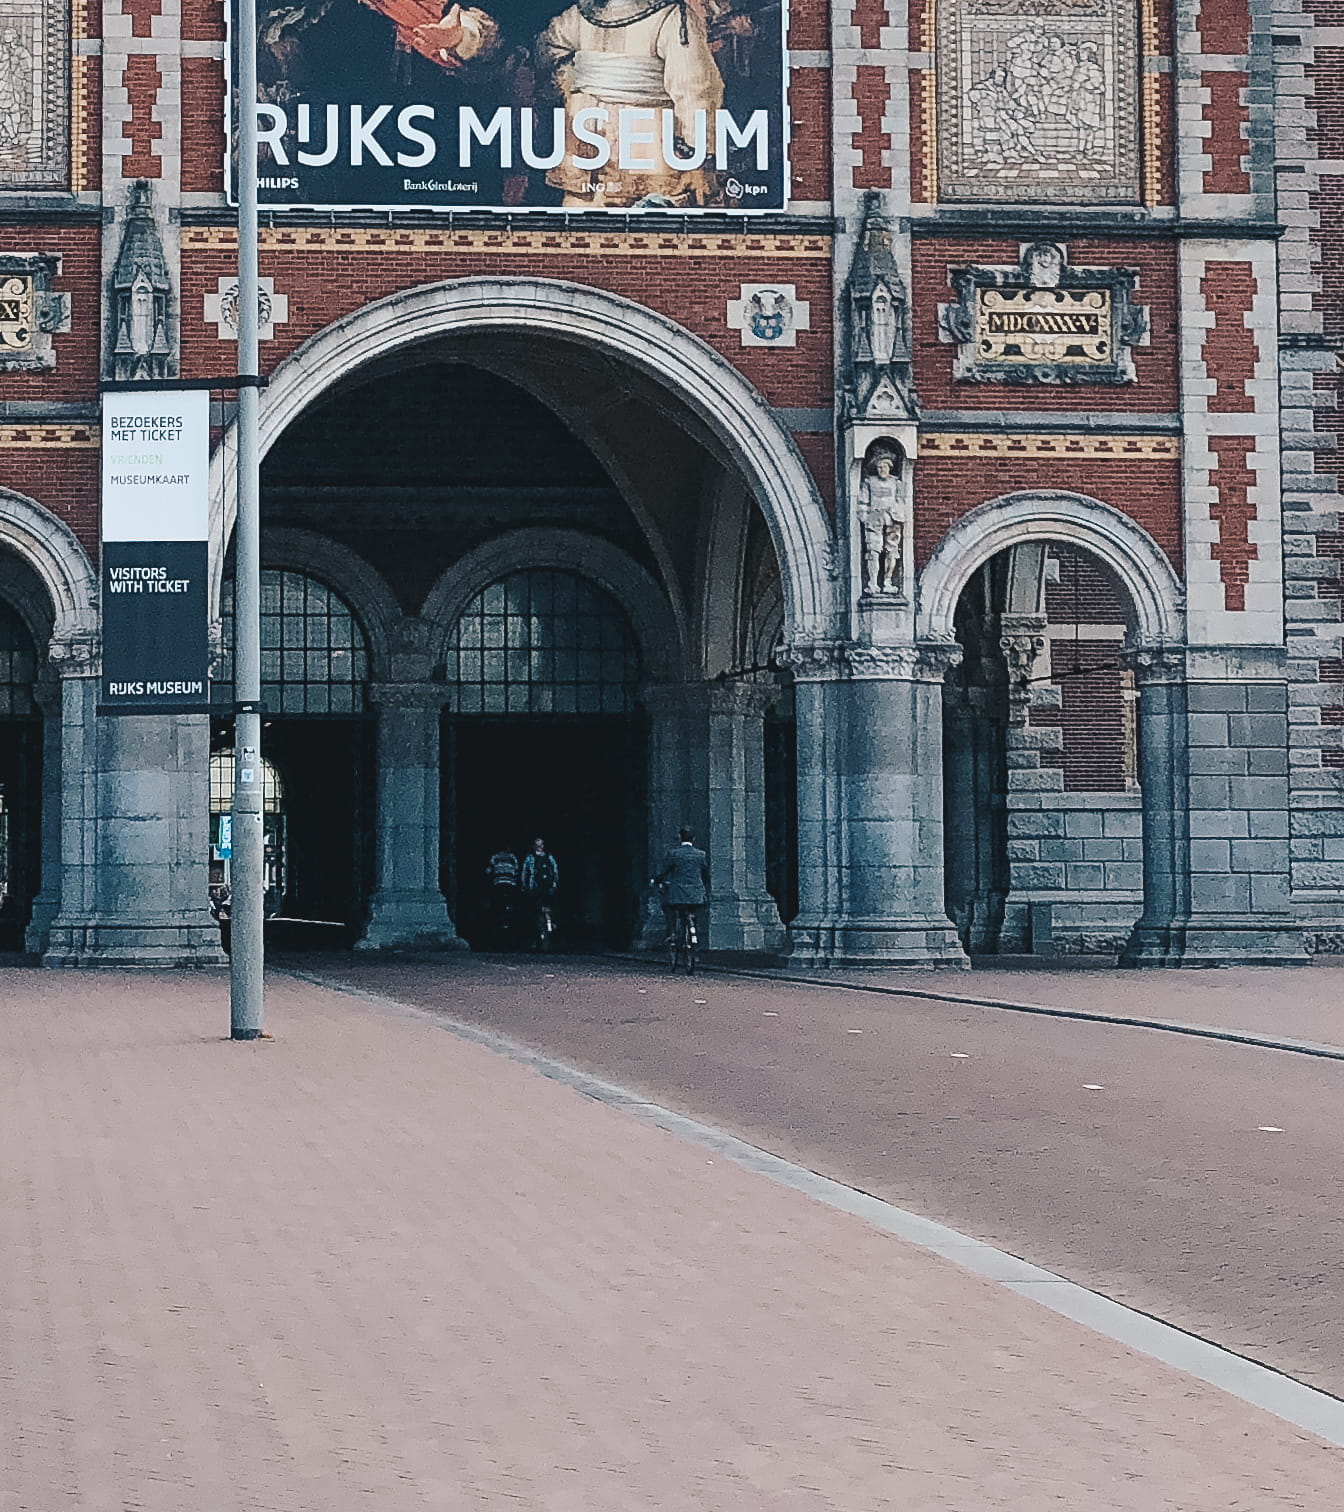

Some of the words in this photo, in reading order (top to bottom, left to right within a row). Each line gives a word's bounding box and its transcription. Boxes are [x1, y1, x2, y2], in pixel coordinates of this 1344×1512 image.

[459, 106, 768, 171] MUSEUM
[256, 177, 299, 189] HILIPS
[582, 182, 604, 193] ING
[745, 183, 768, 195] kpn
[111, 416, 183, 428] BEZOEKERS
[111, 429, 136, 441] MET
[140, 429, 182, 441] TICKET
[111, 474, 190, 485] MUSEUMKAART
[109, 567, 167, 580] VISITORS
[109, 580, 143, 593] WITH
[147, 580, 190, 593] TICKET
[109, 682, 144, 695] RIJKS
[146, 681, 202, 694] MUSEUM
